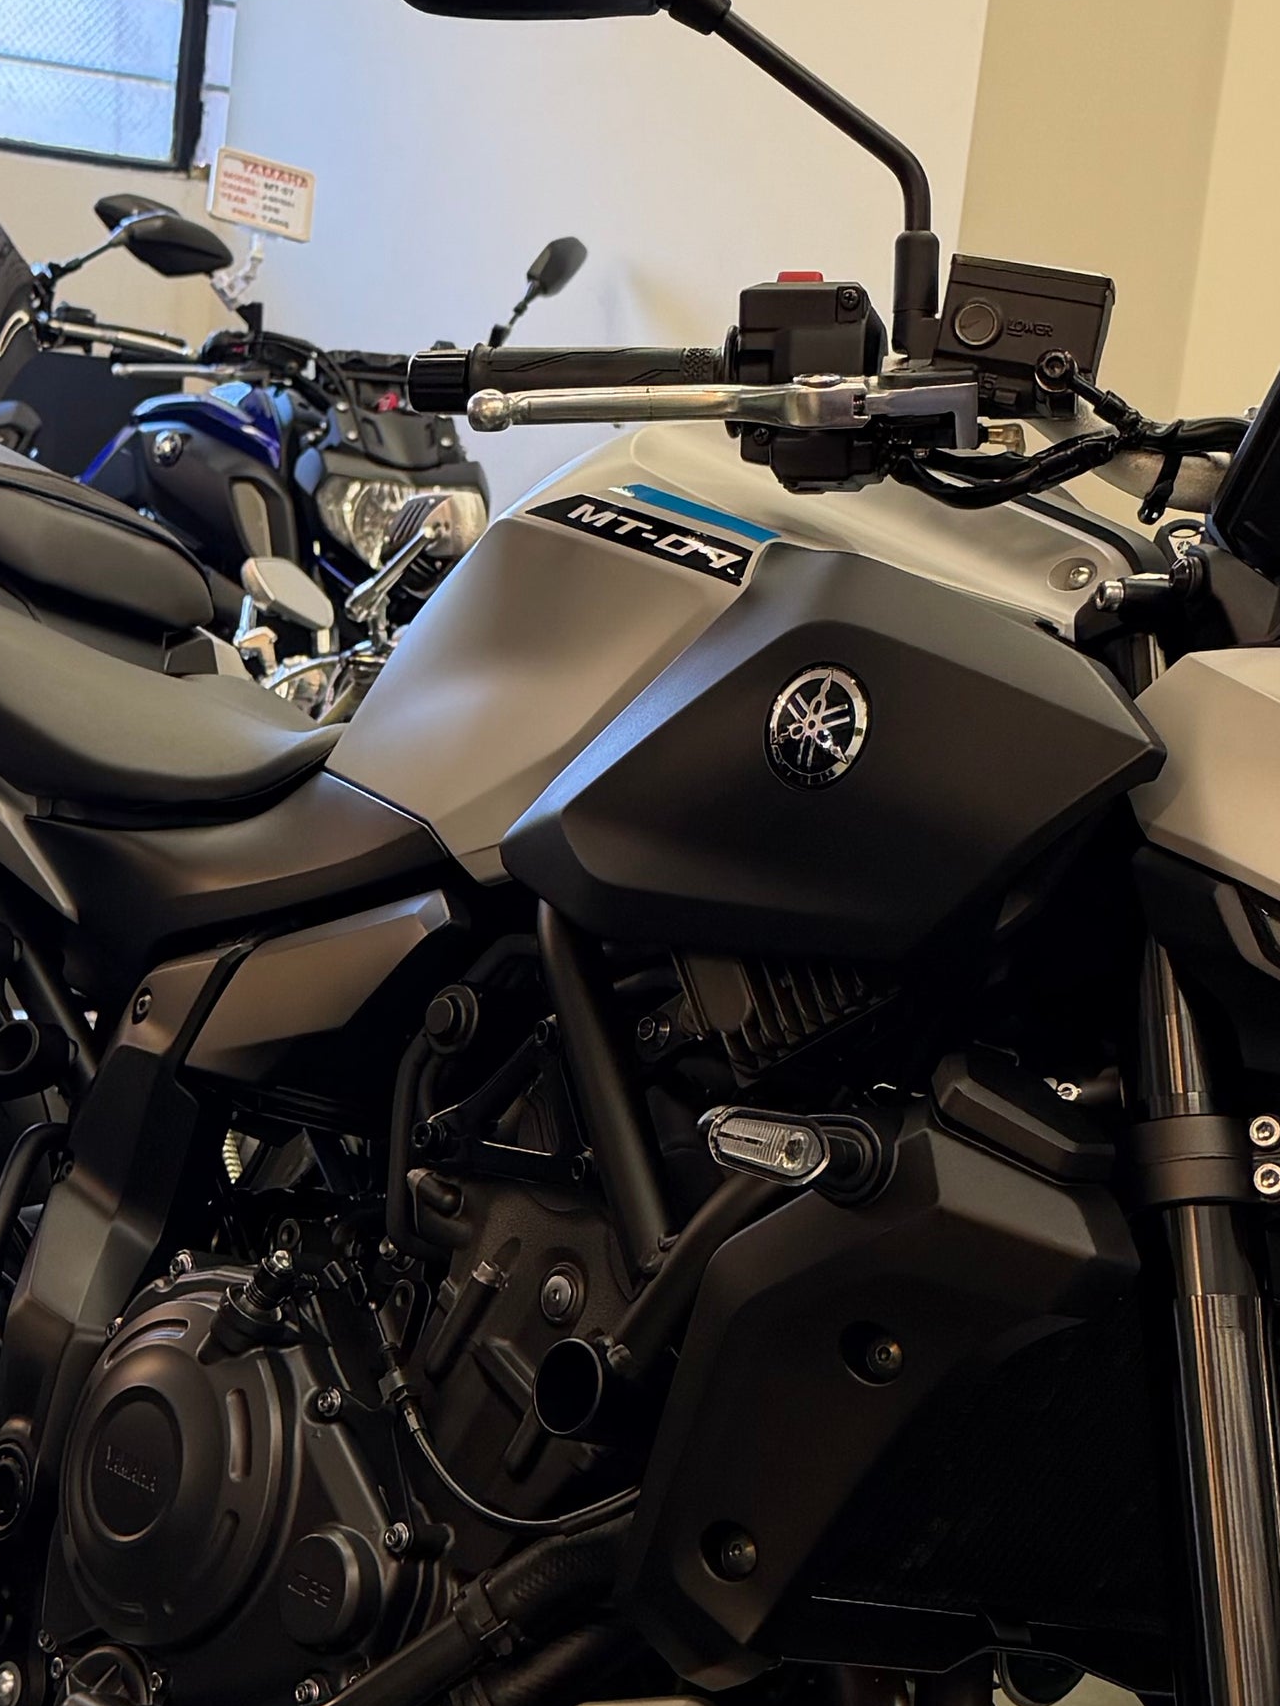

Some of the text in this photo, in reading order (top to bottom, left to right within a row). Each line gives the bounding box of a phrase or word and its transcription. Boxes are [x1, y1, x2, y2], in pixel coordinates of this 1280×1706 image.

[241, 160, 309, 189] YAMAHA
[1006, 316, 1054, 338] LOWER
[567, 502, 744, 570] MT-07
